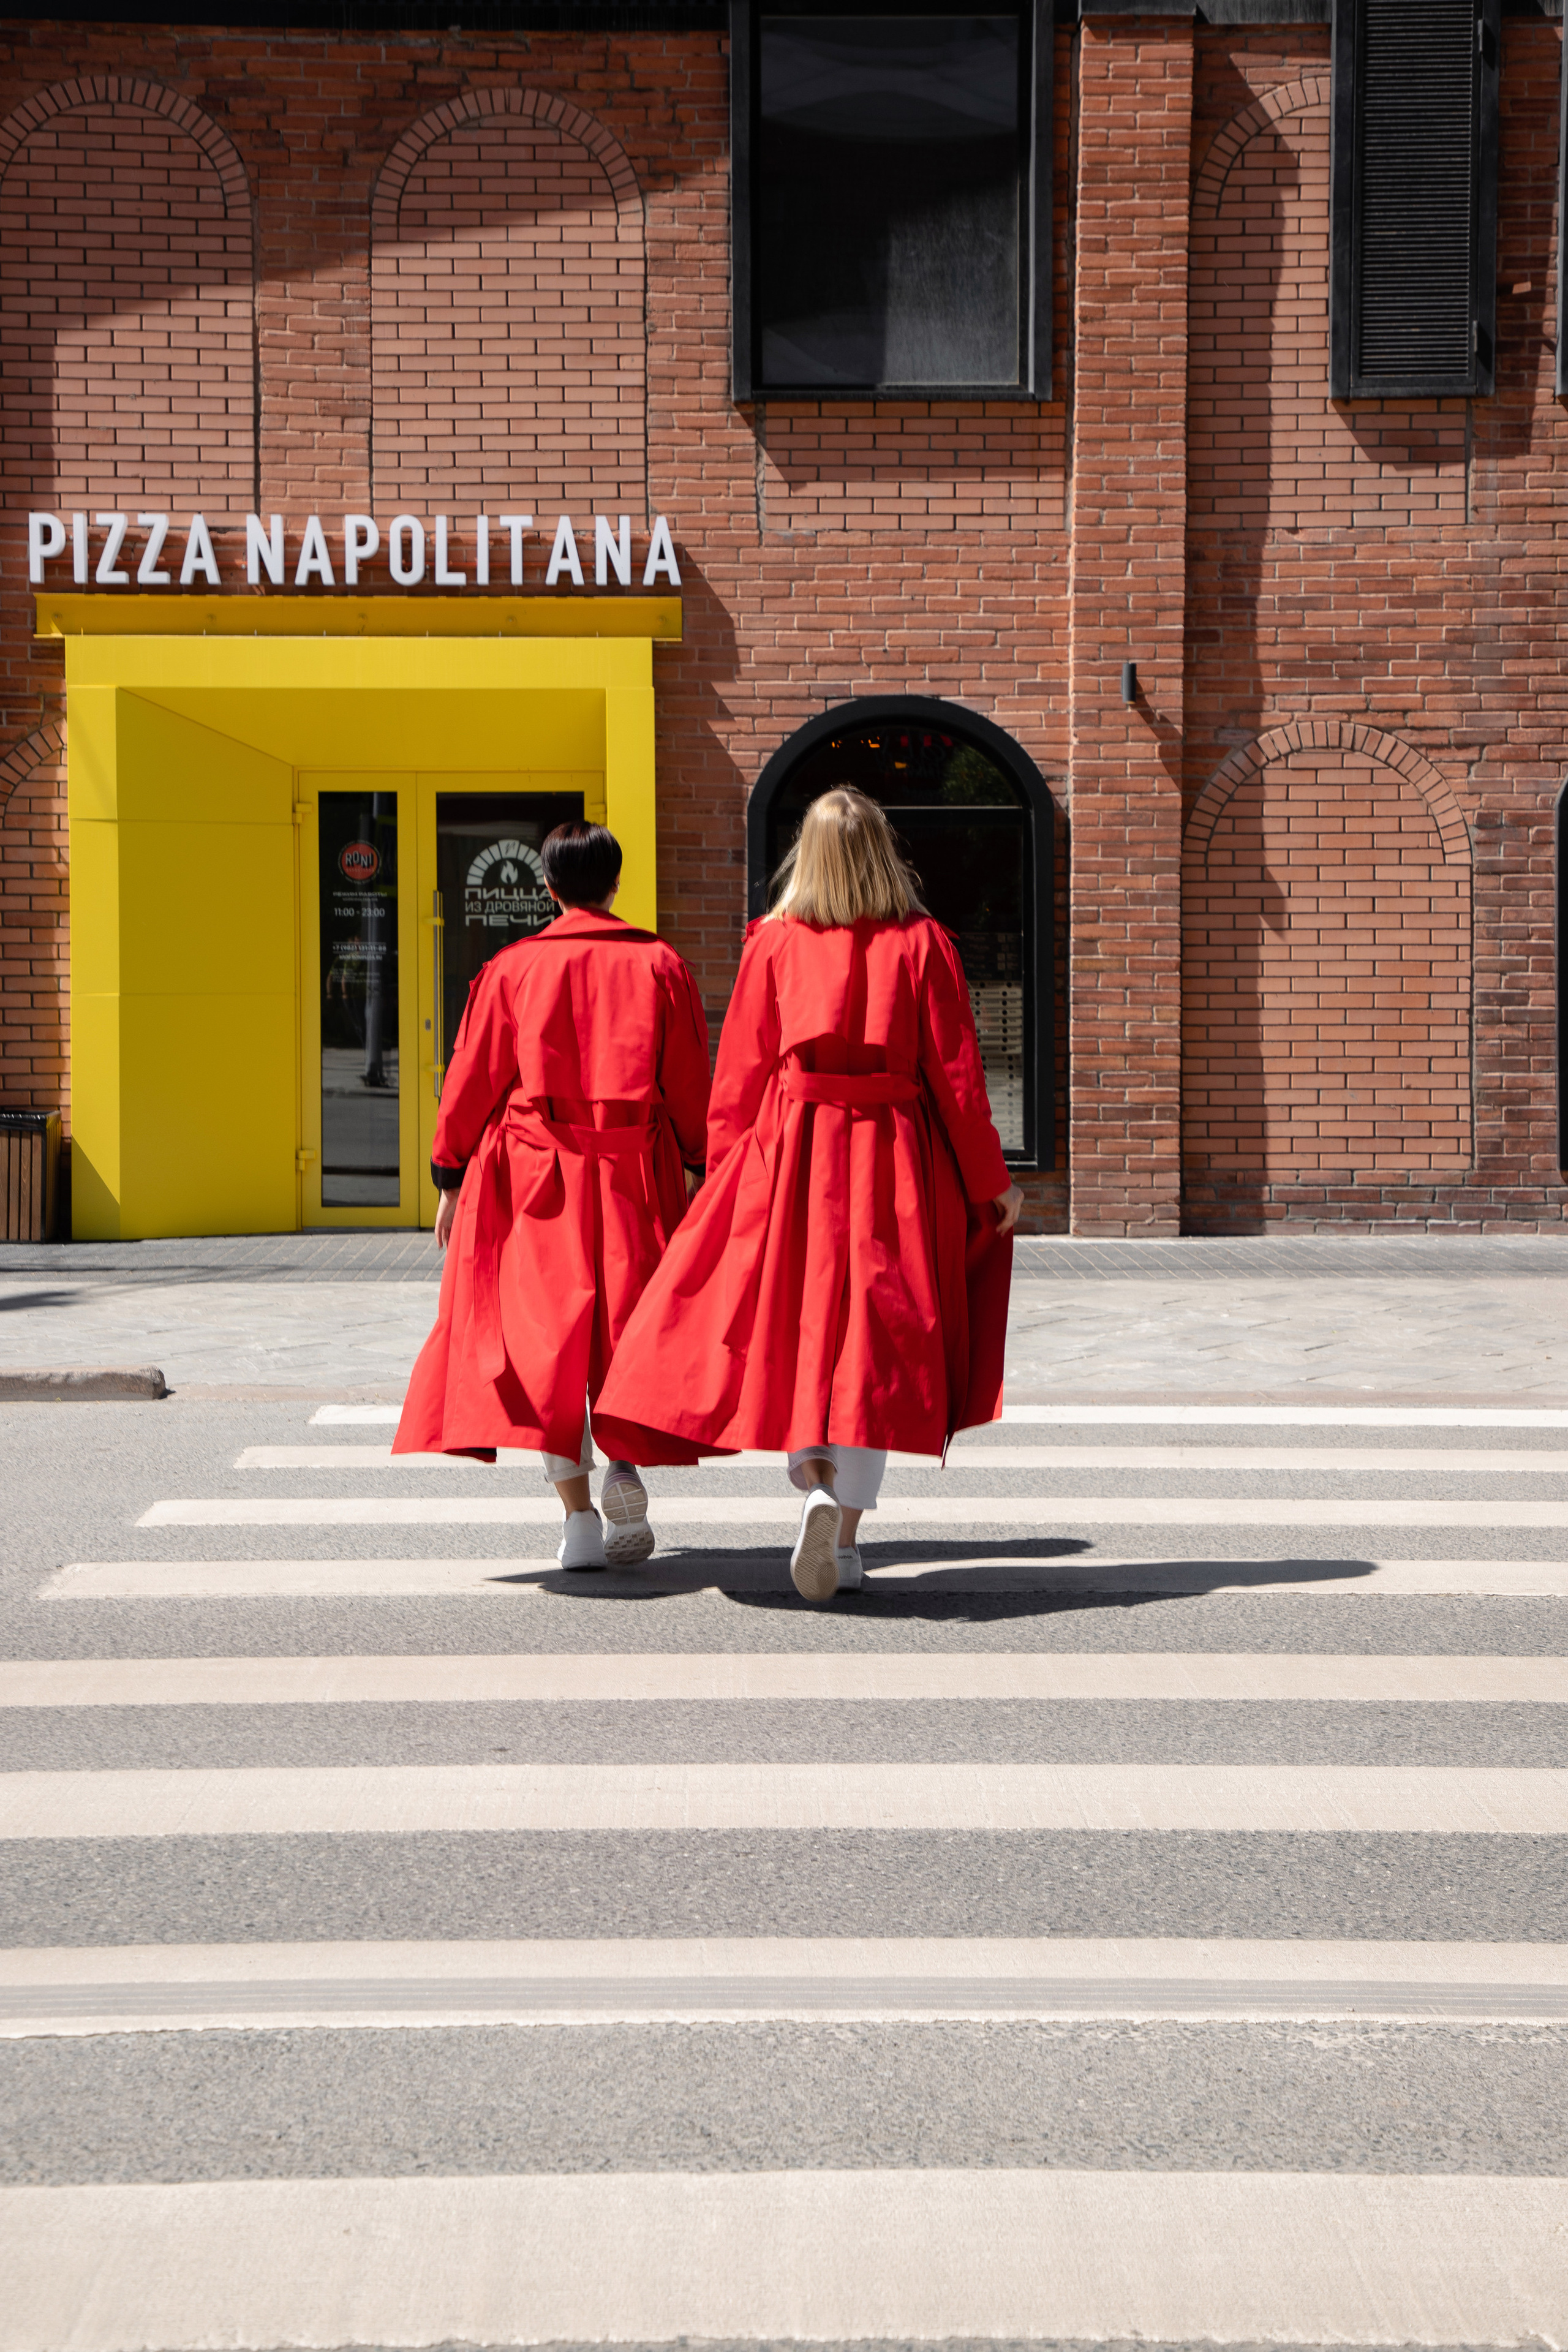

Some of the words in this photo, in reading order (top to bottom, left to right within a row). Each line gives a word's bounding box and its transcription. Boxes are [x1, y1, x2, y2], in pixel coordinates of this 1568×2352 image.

[29, 512, 221, 585] PIZZA
[246, 513, 682, 586] NAPOLITANA
[345, 851, 372, 868] RONI
[334, 907, 355, 917] 11:00
[361, 907, 385, 918] 23:00
[465, 901, 481, 912] ИЗ
[484, 899, 555, 913] ДРОВЯНОЙ
[465, 914, 555, 927] ПЕЧИ
